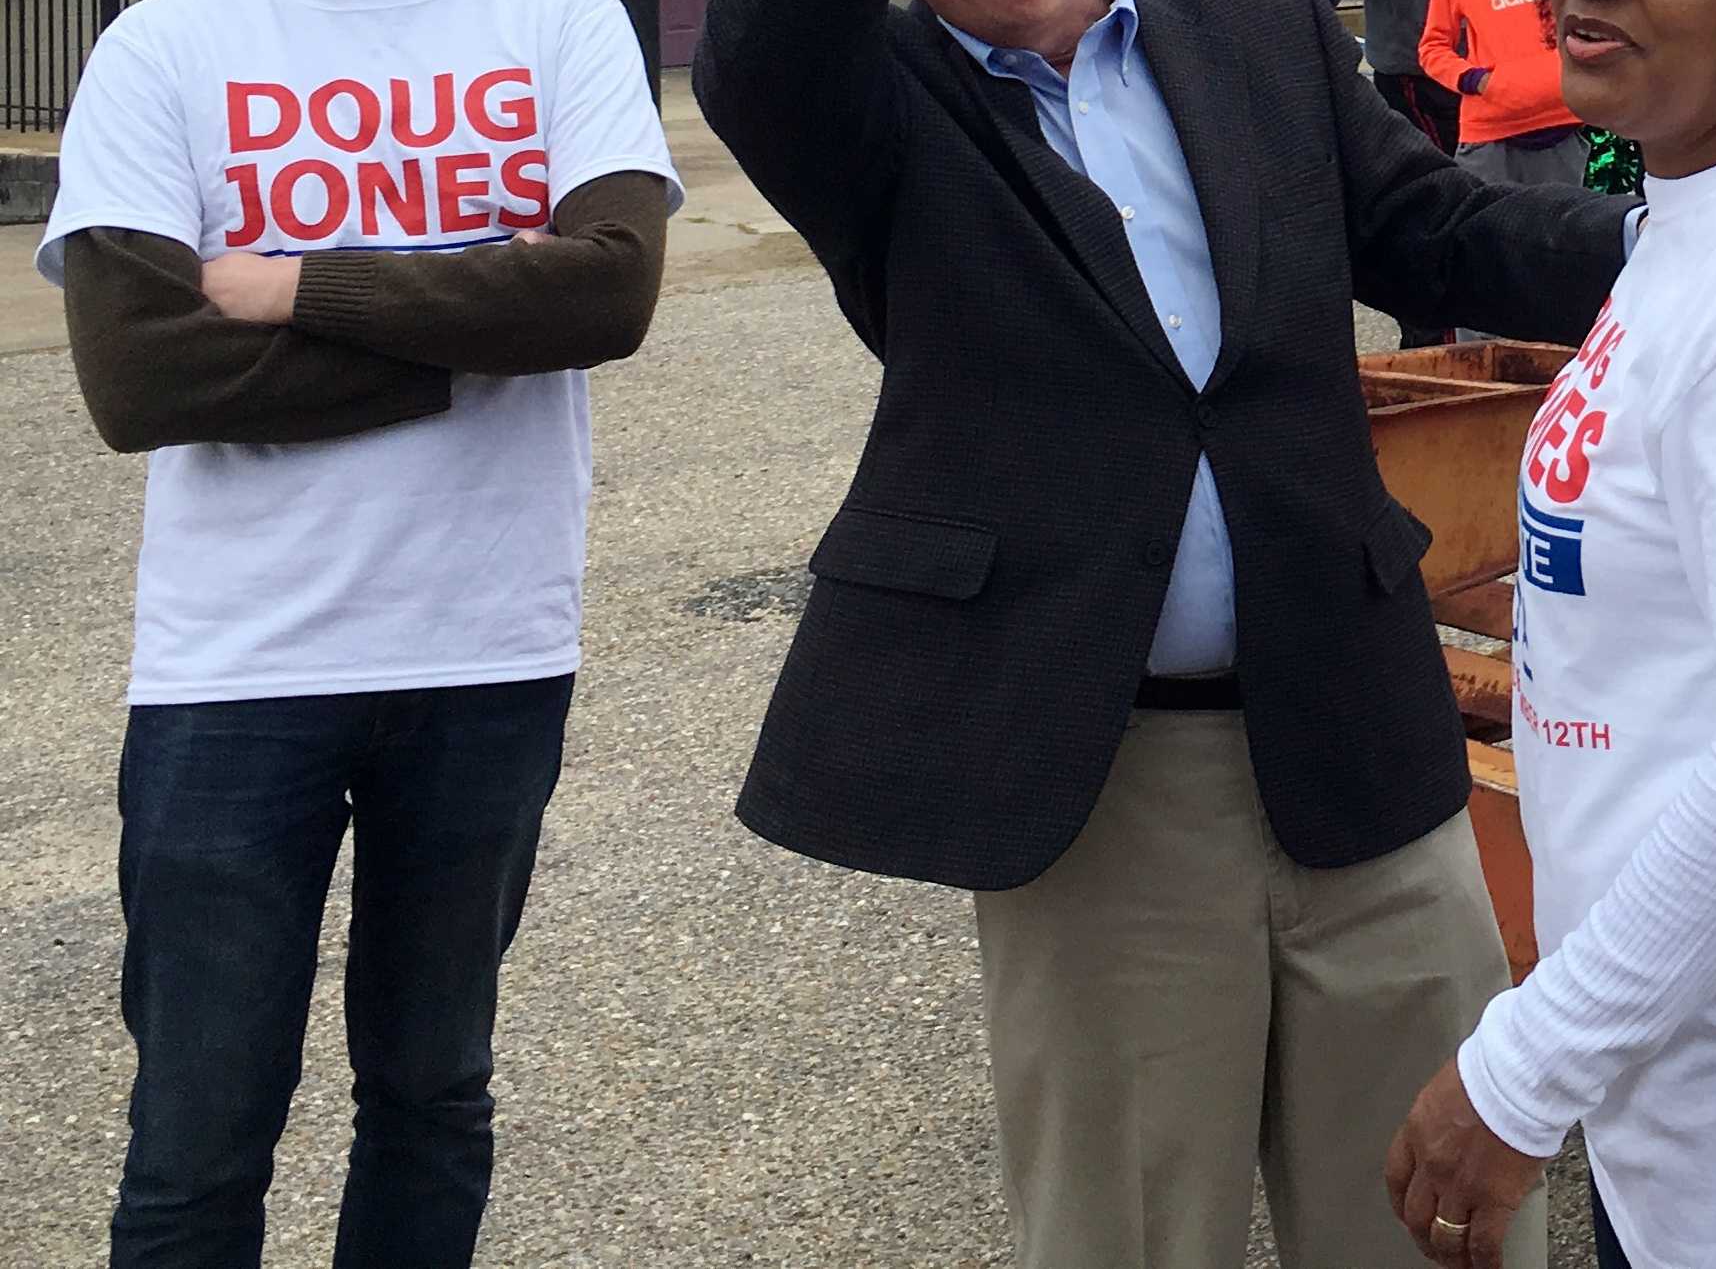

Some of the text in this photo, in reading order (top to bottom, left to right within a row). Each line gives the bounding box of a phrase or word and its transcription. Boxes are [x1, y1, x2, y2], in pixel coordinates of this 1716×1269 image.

[227, 68, 537, 153] DOUG
[224, 150, 549, 247] JONES
[1542, 719, 1610, 749] 12TH
